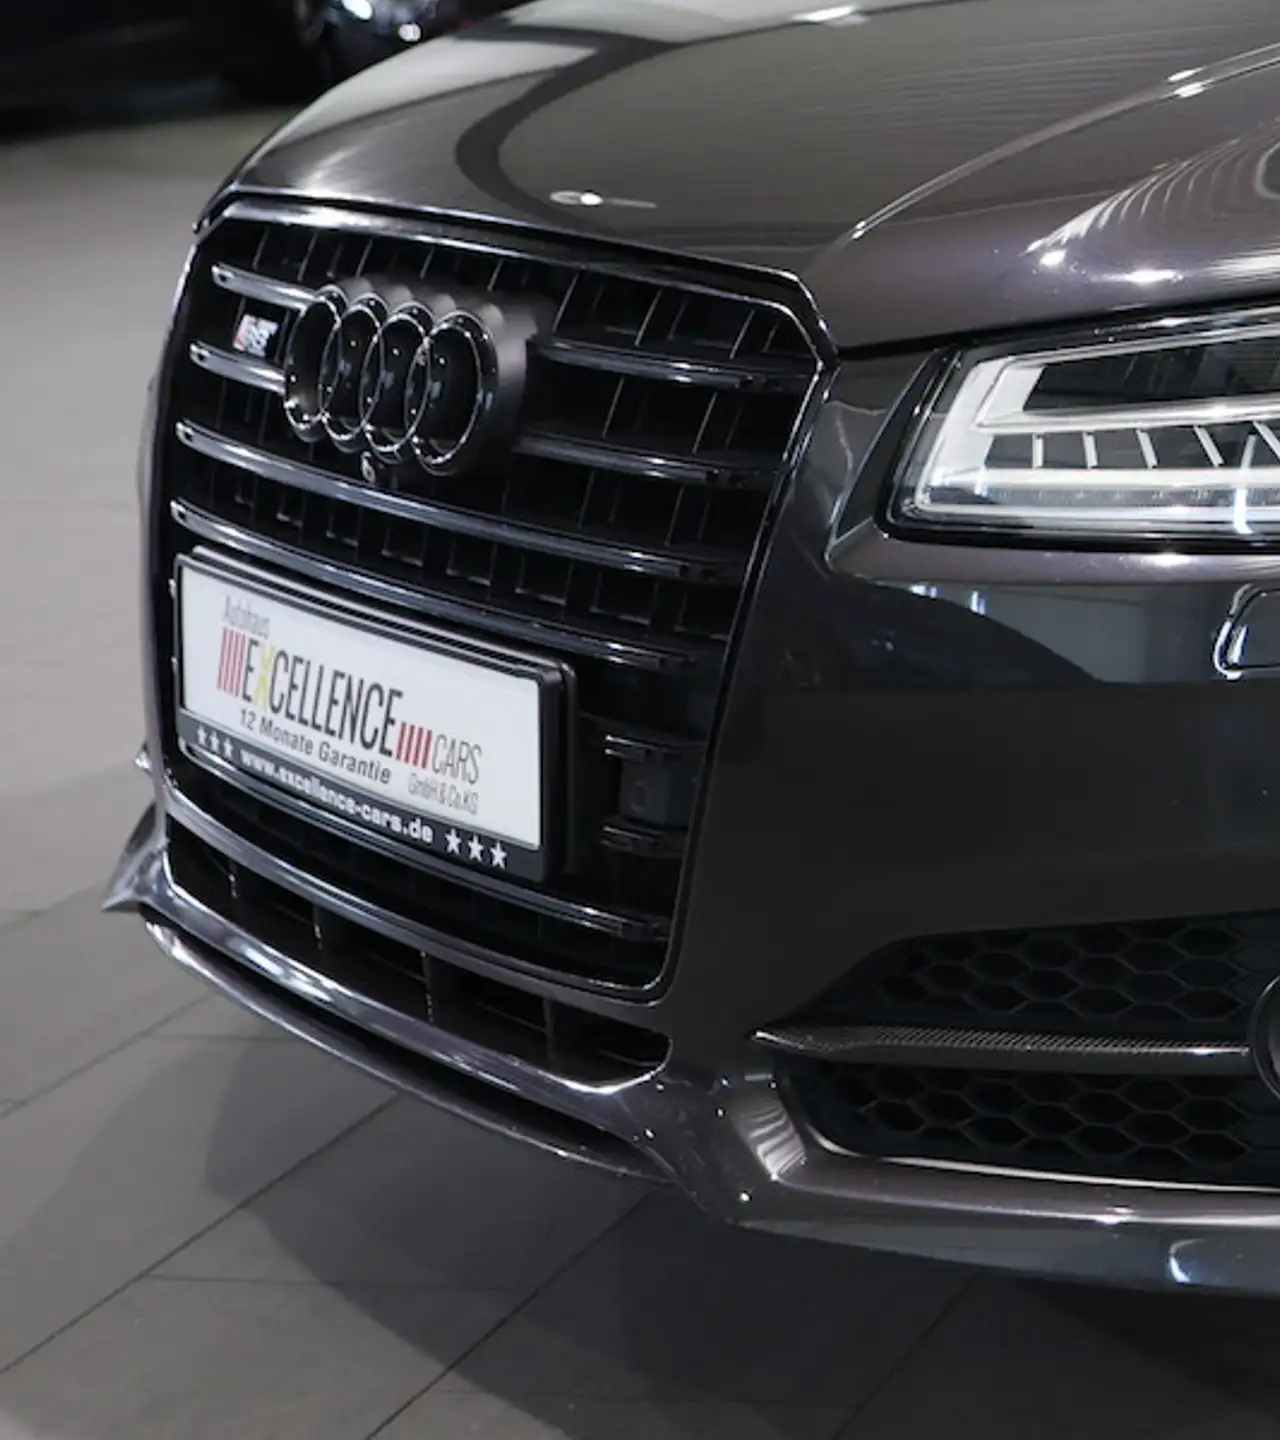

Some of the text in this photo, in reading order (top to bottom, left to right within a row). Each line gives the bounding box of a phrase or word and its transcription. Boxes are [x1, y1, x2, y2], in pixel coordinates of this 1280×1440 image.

[240, 708, 392, 785] 12 Monate Garantie
[242, 638, 483, 785] EXCELLENCE CARS
[240, 749, 434, 844] www.excellence-cars.de
